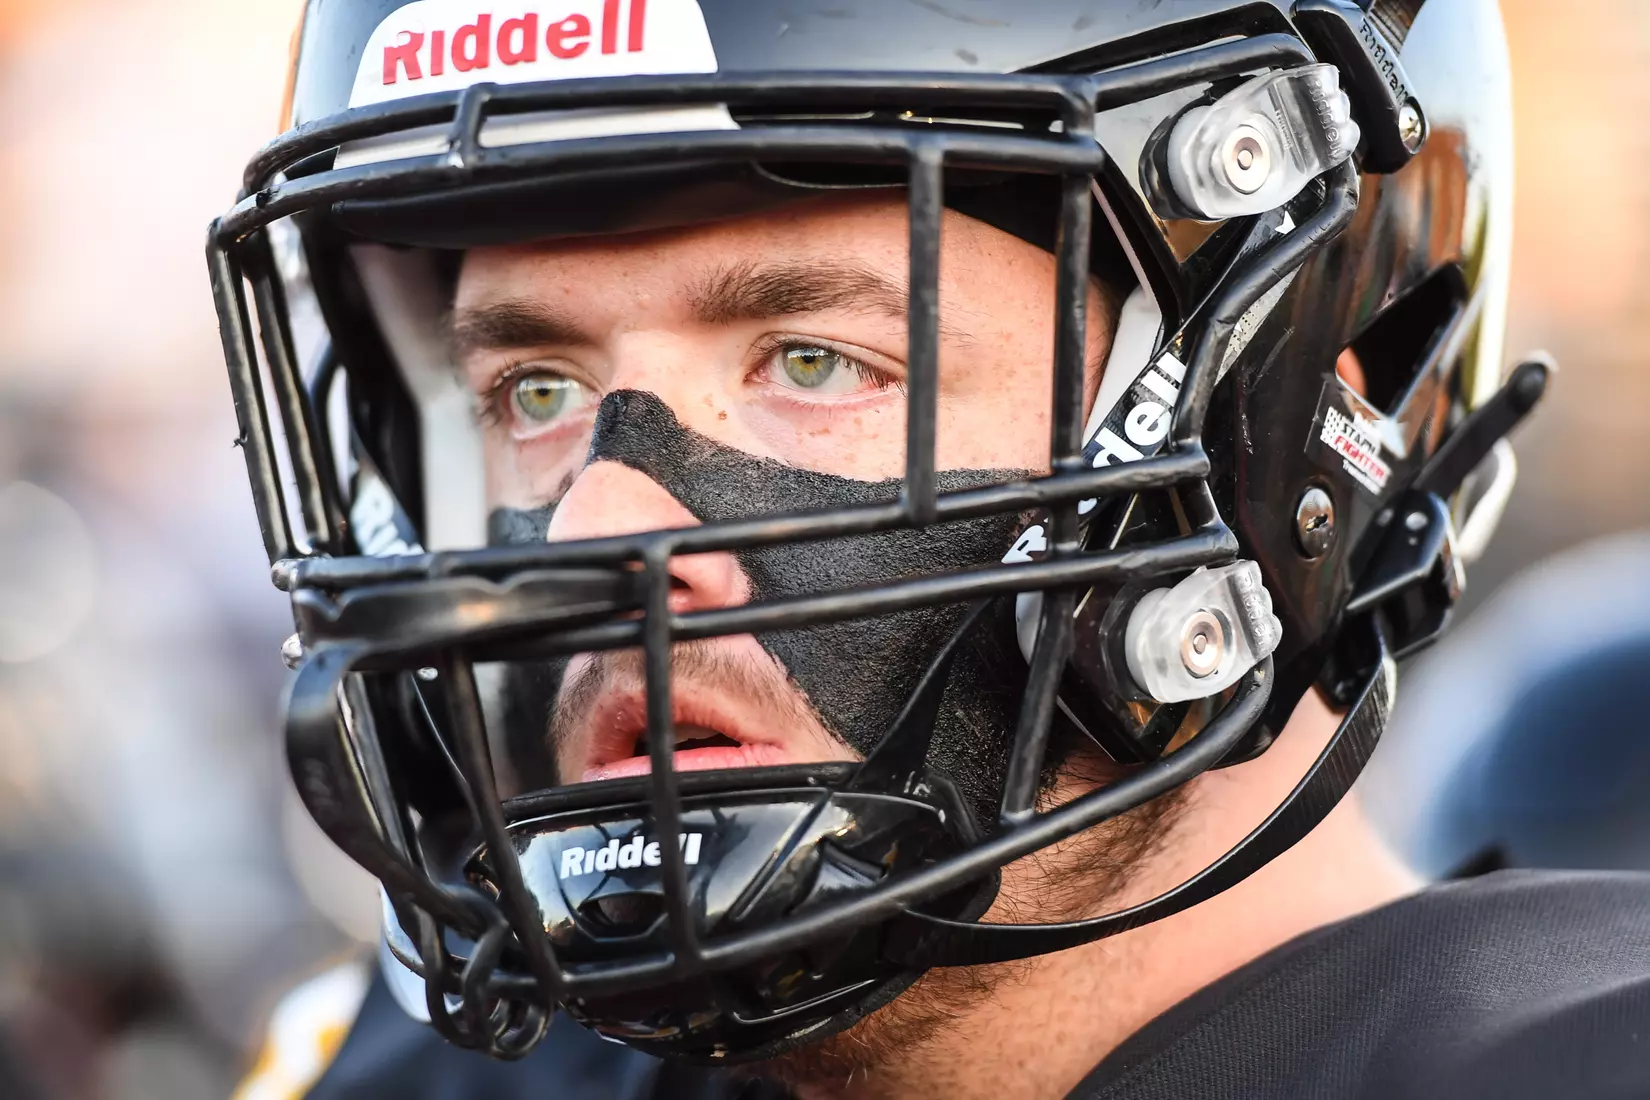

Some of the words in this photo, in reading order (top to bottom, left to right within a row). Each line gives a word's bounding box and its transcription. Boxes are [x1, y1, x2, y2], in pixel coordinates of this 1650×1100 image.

[383, 0, 647, 85] Riddell
[1001, 352, 1187, 563] Rdell
[560, 833, 703, 879] Riddel
